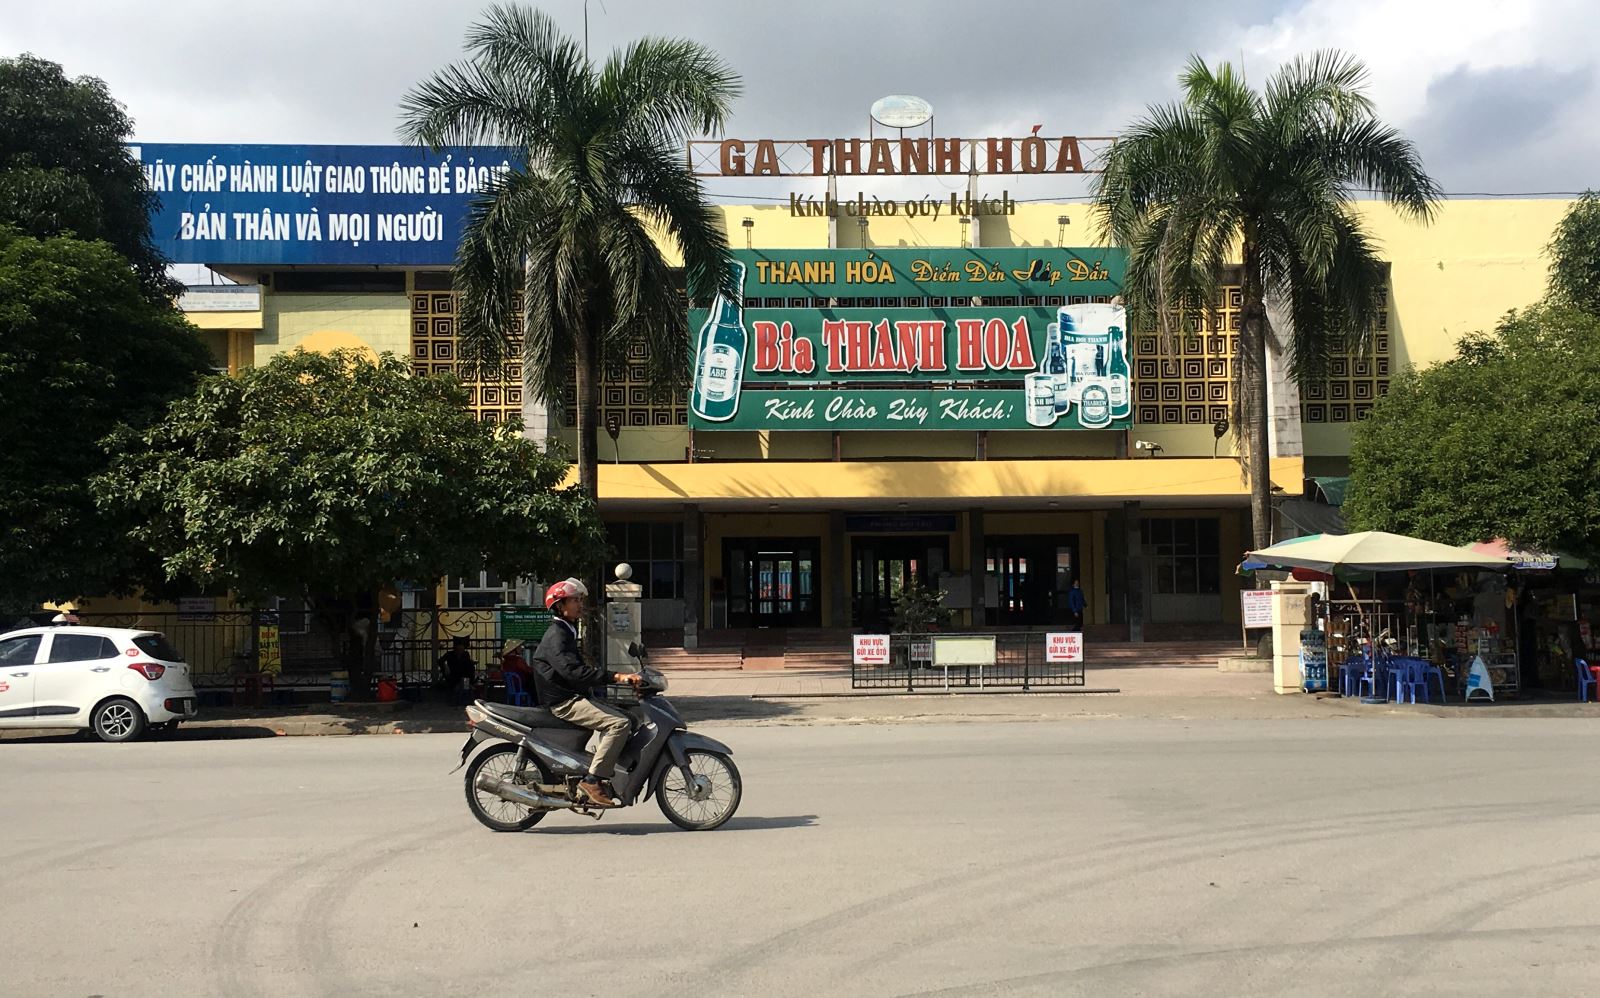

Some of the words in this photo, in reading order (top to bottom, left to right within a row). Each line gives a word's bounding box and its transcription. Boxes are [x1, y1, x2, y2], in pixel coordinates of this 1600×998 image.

[720, 139, 780, 176] GA
[807, 138, 961, 176] THANH
[987, 125, 1083, 174] HÓA
[181, 155, 227, 192] CHẤP
[230, 160, 277, 193] HÀNH
[282, 160, 322, 197] LUẬT
[325, 165, 365, 193] GIAO
[370, 161, 425, 194] THÔNG
[428, 154, 452, 194] ĐỂ
[455, 156, 489, 193] BẢO
[181, 203, 226, 240] BẢN
[233, 207, 290, 241] THÂN
[295, 207, 322, 241] VÀ
[328, 213, 370, 247] MỌI
[377, 205, 443, 241] NGƯỜI
[755, 261, 835, 284] THANH
[846, 253, 896, 284] HÓA
[753, 320, 815, 373] Bia
[822, 318, 947, 373] THANH
[955, 316, 1036, 371] HOA
[764, 398, 815, 420] Kính
[825, 396, 878, 422] Chào
[939, 398, 1014, 421] Khách!
[872, 638, 884, 646] VỰC
[1065, 636, 1076, 645] VỰC
[1068, 645, 1080, 653] MÁY
